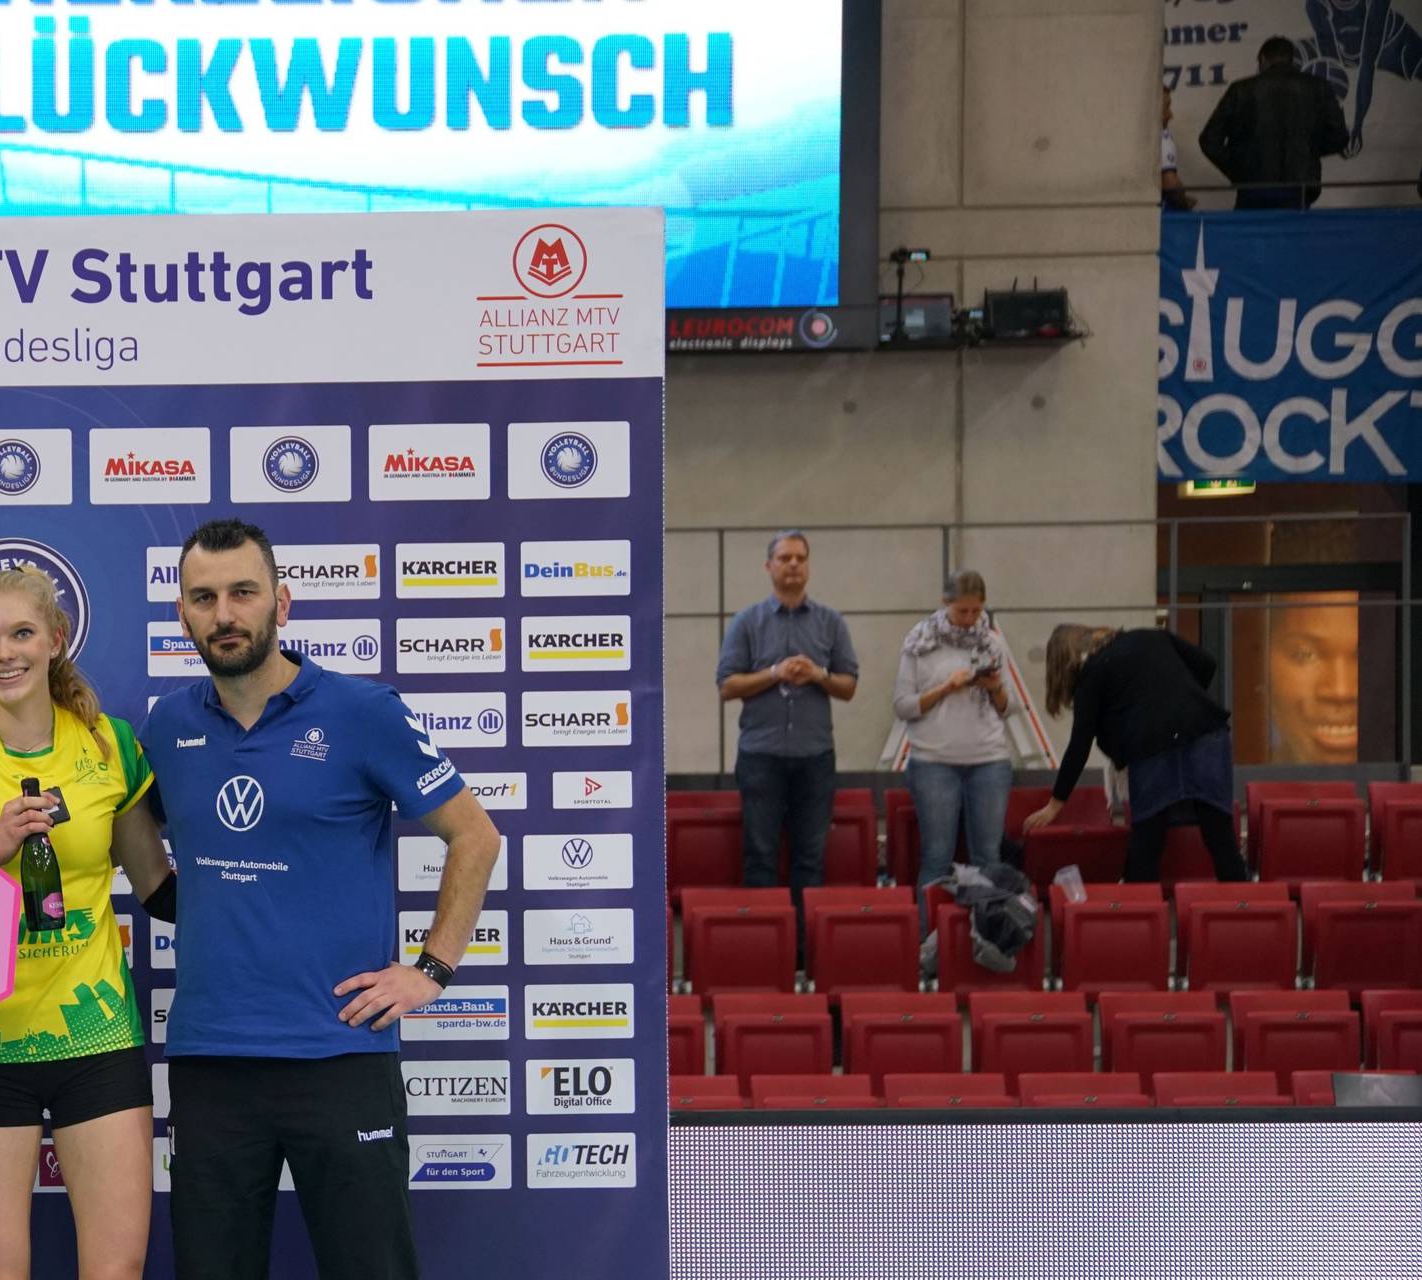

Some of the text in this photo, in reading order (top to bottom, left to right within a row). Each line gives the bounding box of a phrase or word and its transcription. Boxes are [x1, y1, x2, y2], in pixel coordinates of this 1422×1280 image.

[69, 247, 374, 316] Stuttgart
[479, 307, 620, 327] ALLIANZ MTV
[479, 332, 620, 355] STUTTGART
[669, 336, 793, 350] electronic displays
[269, 441, 312, 461] VOLLEYBALL
[548, 438, 591, 458] VOLLEYBALL
[270, 469, 313, 487] BUNDESLIGA
[549, 465, 590, 483] BUNDESLIGA
[277, 565, 359, 579] SCHARR
[402, 560, 496, 575] KÄRCHER
[524, 562, 627, 578] DeinBus.de
[278, 639, 347, 657] Allianz
[399, 639, 484, 653] SCHARR
[528, 633, 623, 648] KÄRCHER
[525, 713, 610, 727] SCHARR
[177, 735, 206, 748] hummel
[195, 856, 288, 871] Volkswagen Automobile
[221, 870, 257, 882] Stuttgart
[549, 935, 611, 945] Haus & Grund
[532, 1001, 627, 1016] KÄRCHER
[436, 1019, 506, 1030] sparda-bw.de
[405, 1076, 508, 1096] CITIZEN
[553, 1066, 612, 1096] ELO
[553, 1097, 612, 1109] Digital Office
[357, 1126, 393, 1142] hummel
[426, 1149, 467, 1159] STUTTGART
[426, 1167, 485, 1178] für den Sport
[536, 1168, 626, 1179] Fahrzeugentwicklung
